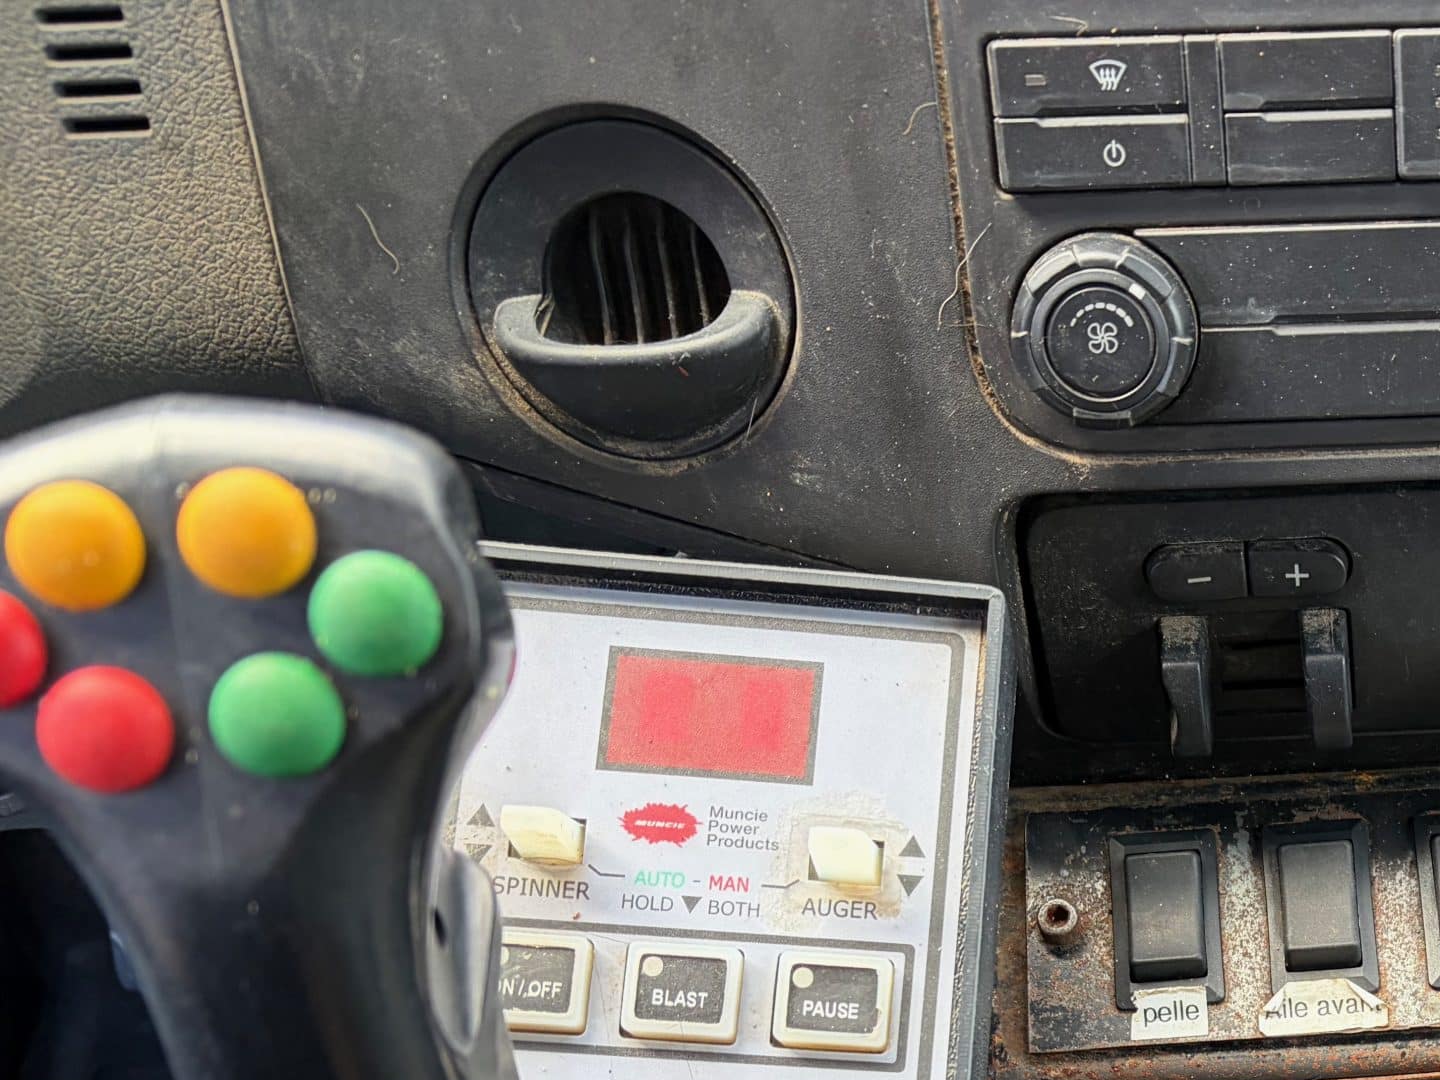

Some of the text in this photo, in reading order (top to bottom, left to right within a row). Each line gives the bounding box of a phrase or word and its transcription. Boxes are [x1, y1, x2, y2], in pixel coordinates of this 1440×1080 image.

[709, 806, 768, 822] Muncie
[633, 819, 687, 830] MUNCIE
[708, 820, 760, 835] Power
[706, 833, 780, 850] Products
[493, 876, 590, 900] SPINNER
[634, 870, 750, 893] AUTO MAN
[621, 894, 761, 917] HOLD BOTH
[801, 898, 878, 919] AUGER
[652, 989, 708, 1009] BLAST
[802, 1000, 860, 1020] PAUSE
[1143, 1001, 1200, 1028] pelle
